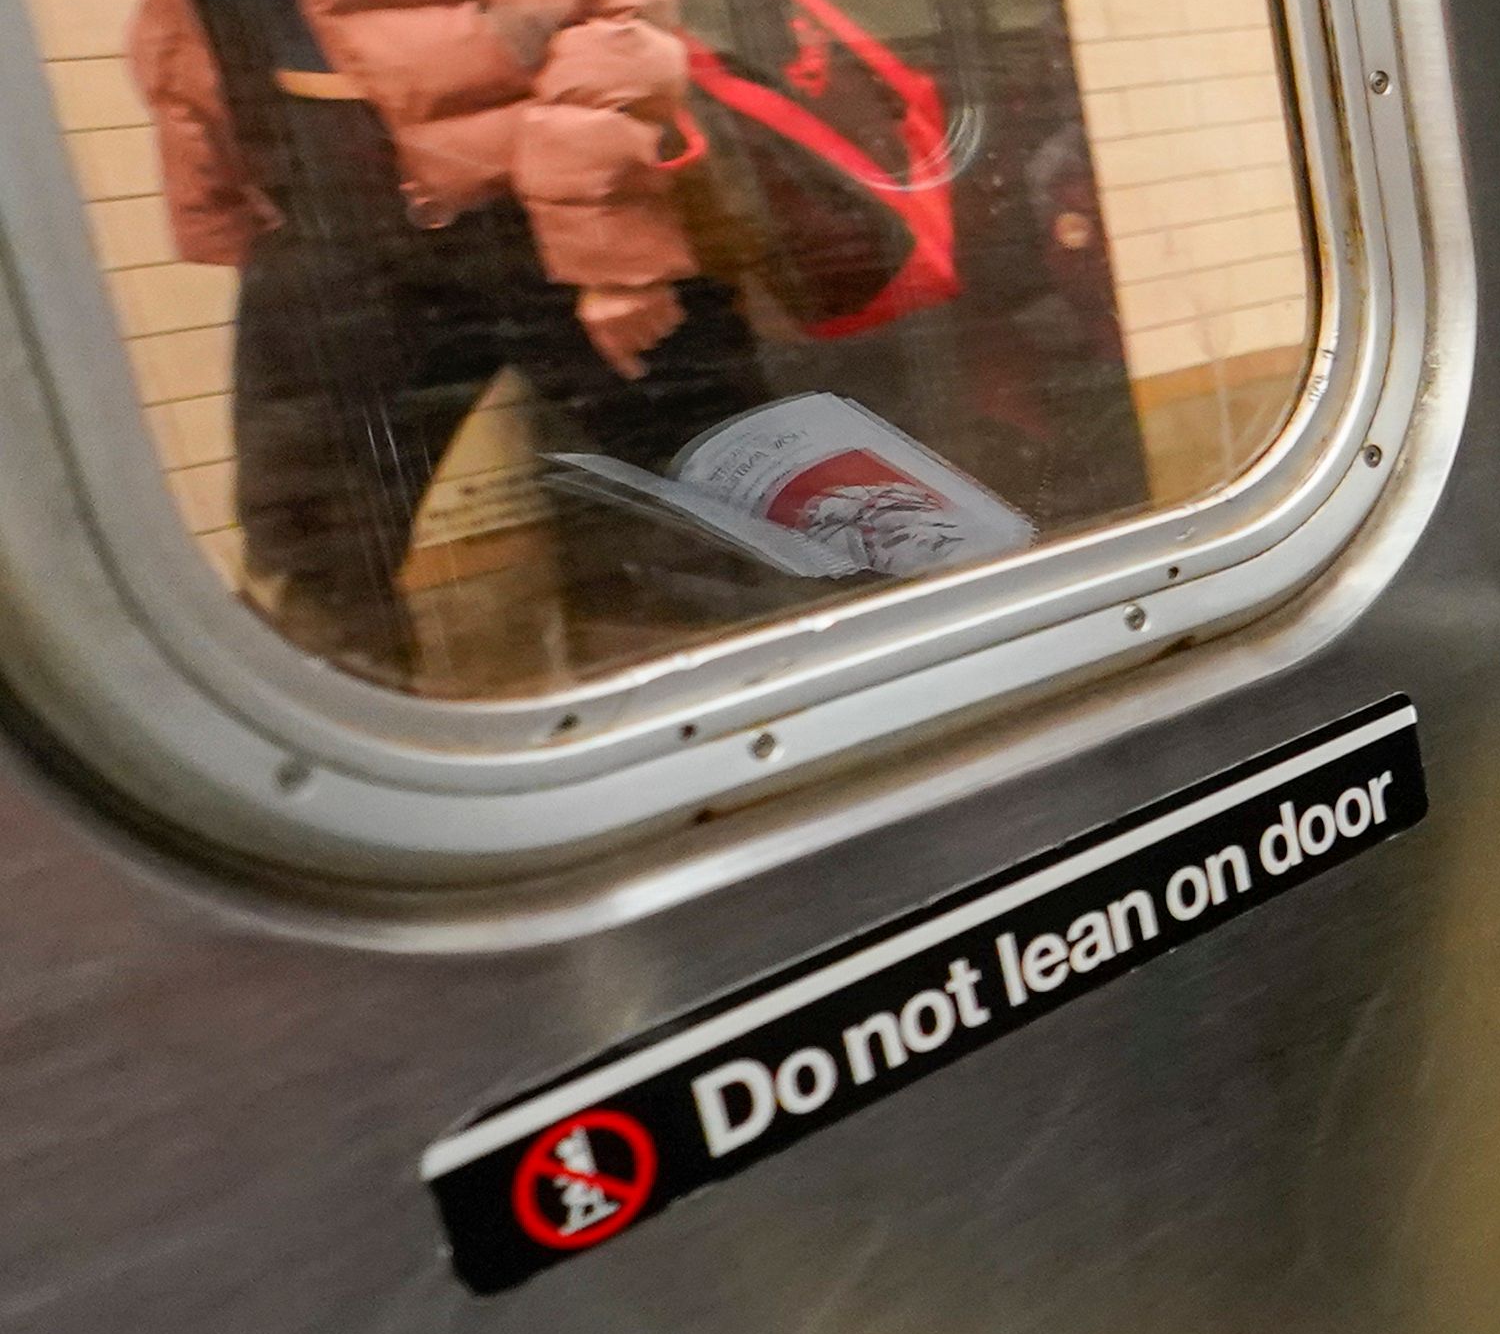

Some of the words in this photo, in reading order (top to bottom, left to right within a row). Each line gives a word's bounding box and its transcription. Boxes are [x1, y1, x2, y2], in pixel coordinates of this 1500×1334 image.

[690, 1046, 838, 1158] Do
[842, 954, 993, 1088] not
[994, 887, 1161, 1008] lean
[1165, 840, 1252, 925] on
[1257, 770, 1395, 877] door
